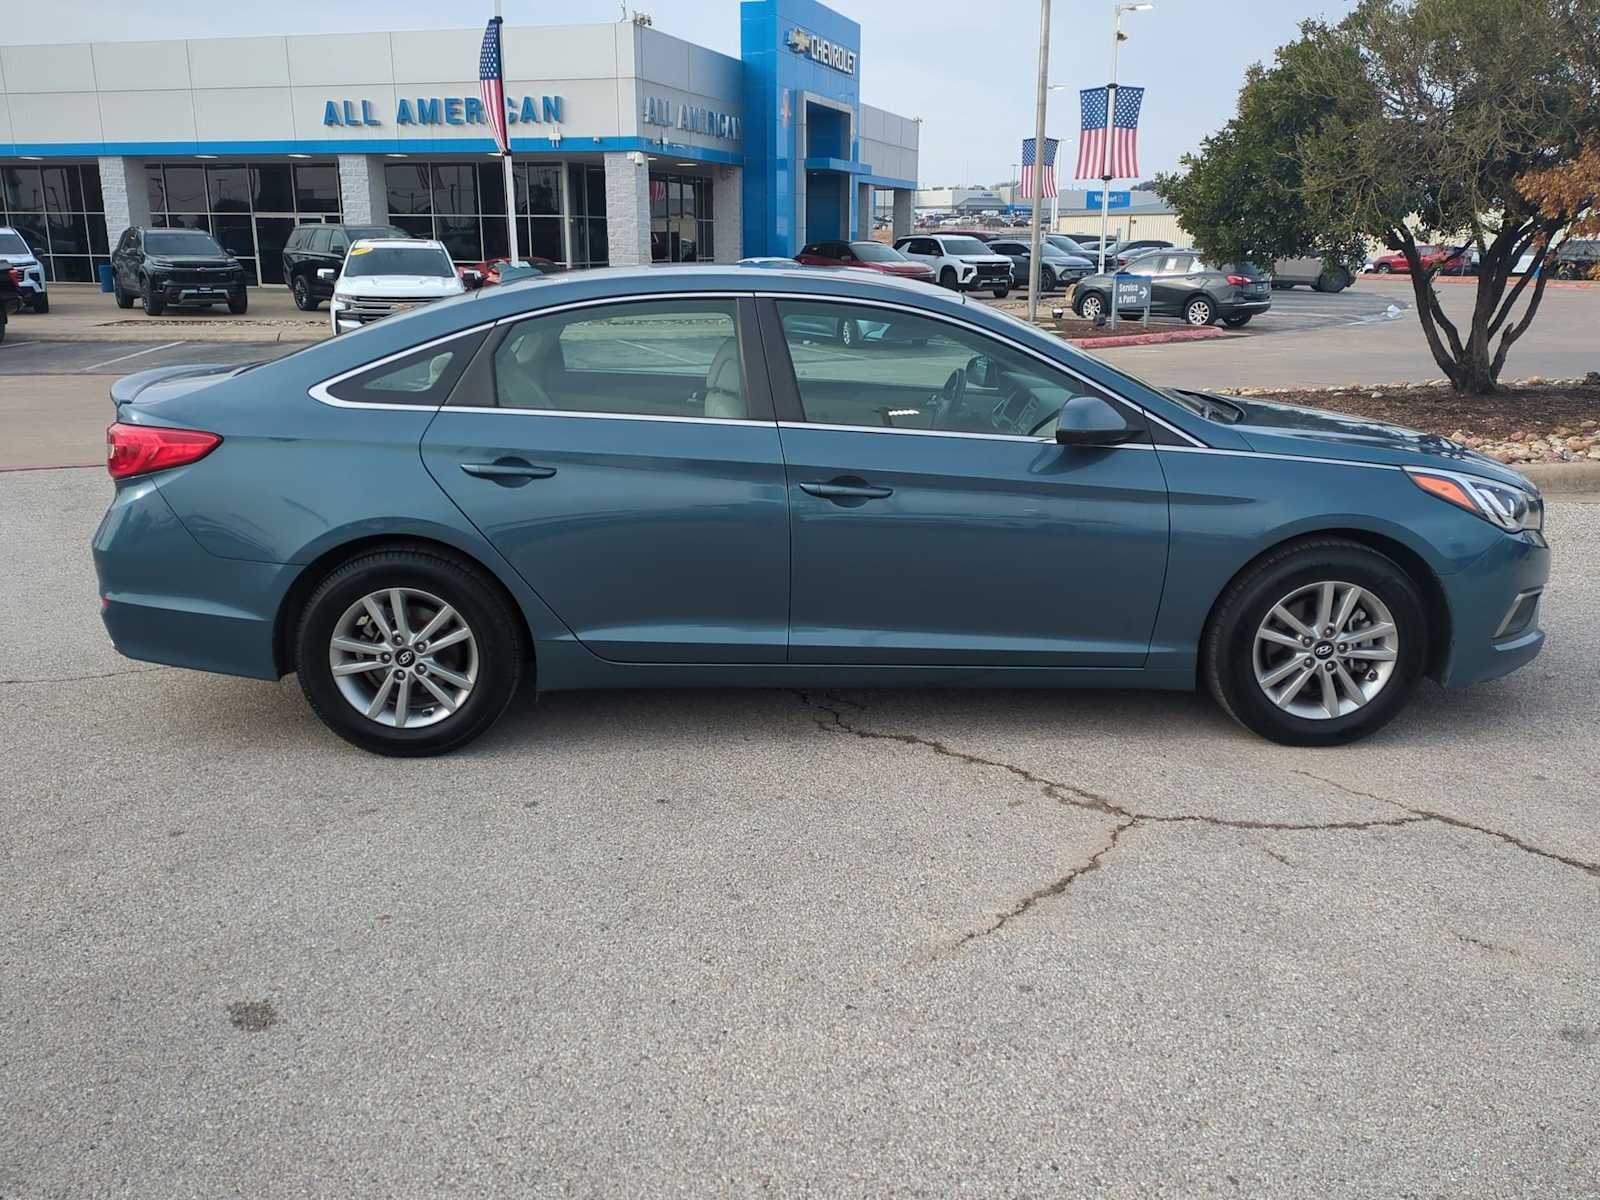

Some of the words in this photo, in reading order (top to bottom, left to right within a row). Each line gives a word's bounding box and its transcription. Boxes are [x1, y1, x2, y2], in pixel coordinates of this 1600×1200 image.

[811, 35, 857, 75] CHEVROLET
[323, 99, 381, 126] ALL
[644, 96, 673, 127] ALL
[1119, 283, 1139, 293] Service
[1123, 295, 1137, 304] Parts
